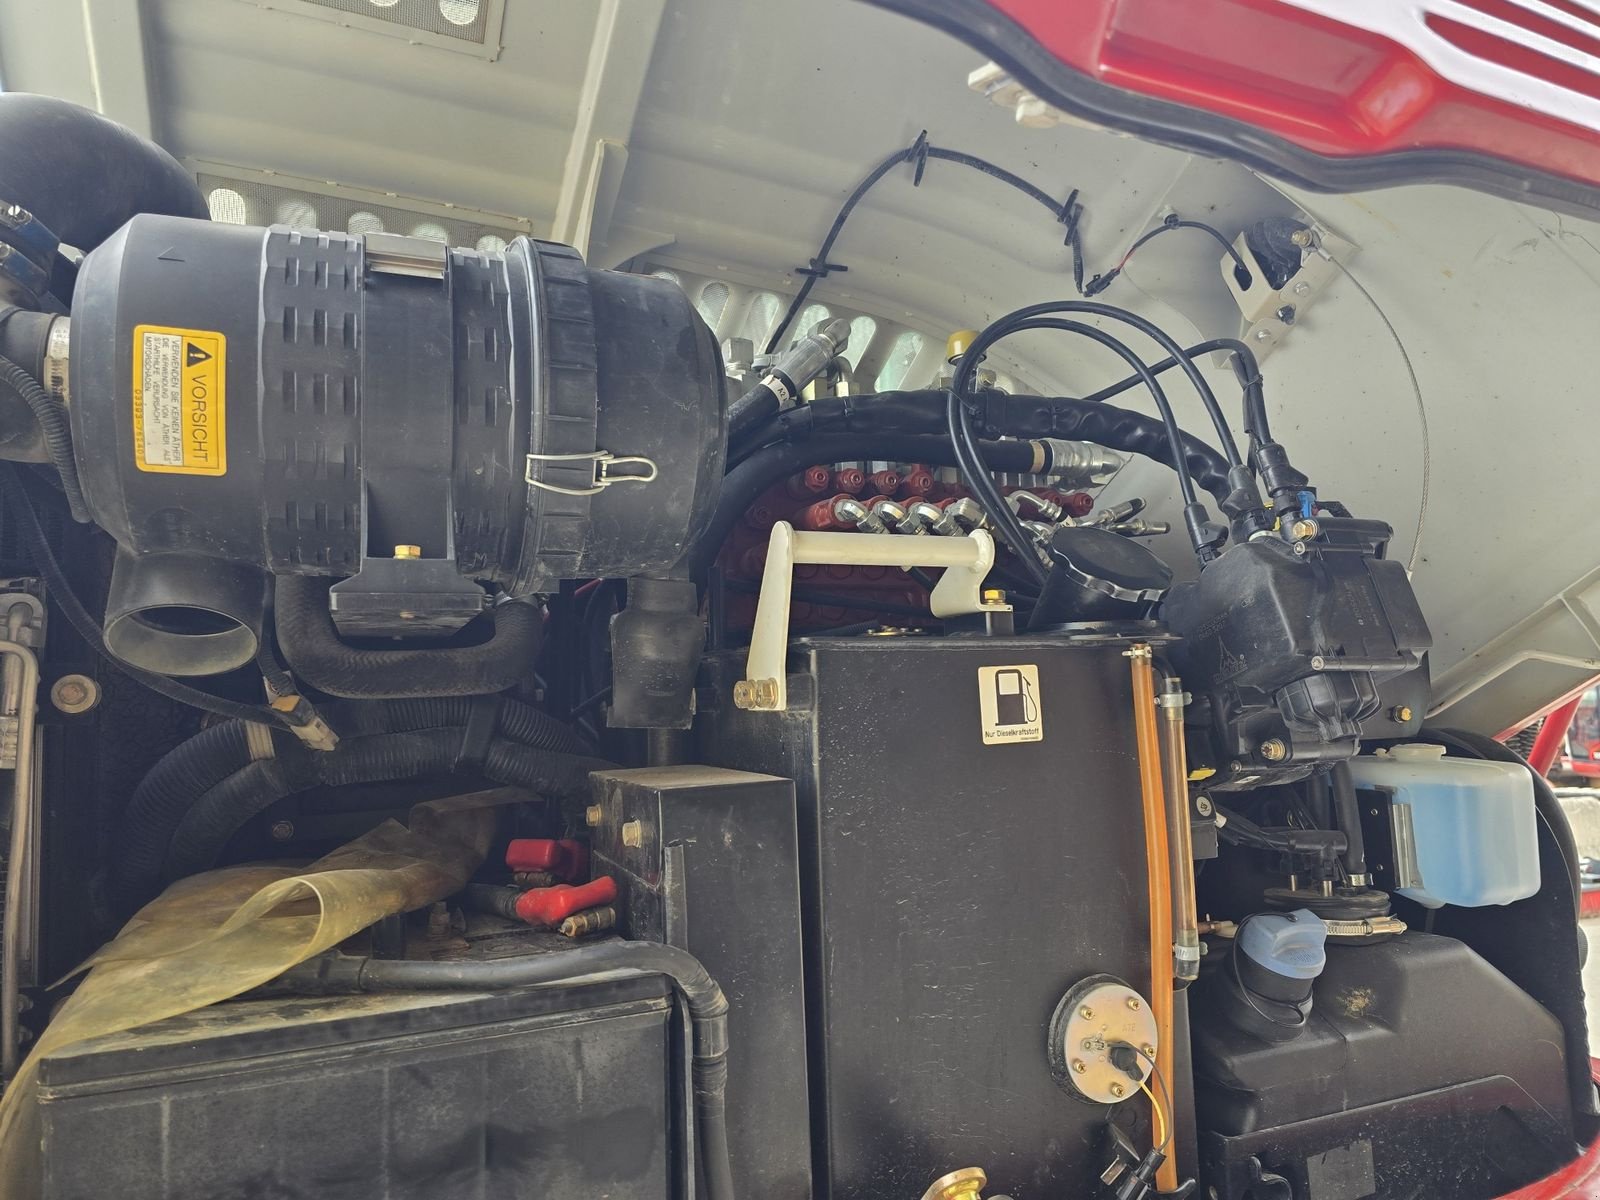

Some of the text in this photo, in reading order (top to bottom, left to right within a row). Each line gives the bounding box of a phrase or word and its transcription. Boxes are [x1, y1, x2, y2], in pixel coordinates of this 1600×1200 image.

[161, 337, 170, 349] DIE
[161, 354, 169, 399] VERWENDUNG
[170, 340, 179, 389] VERWENDEN
[152, 337, 161, 424] STARTHILFE VERURSACHT
[170, 391, 180, 403] SIE
[161, 404, 170, 419] VON
[171, 406, 180, 434] KEINEN
[191, 374, 208, 463] VORSICHT
[996, 728, 1039, 737] Dieselkraftstoff
